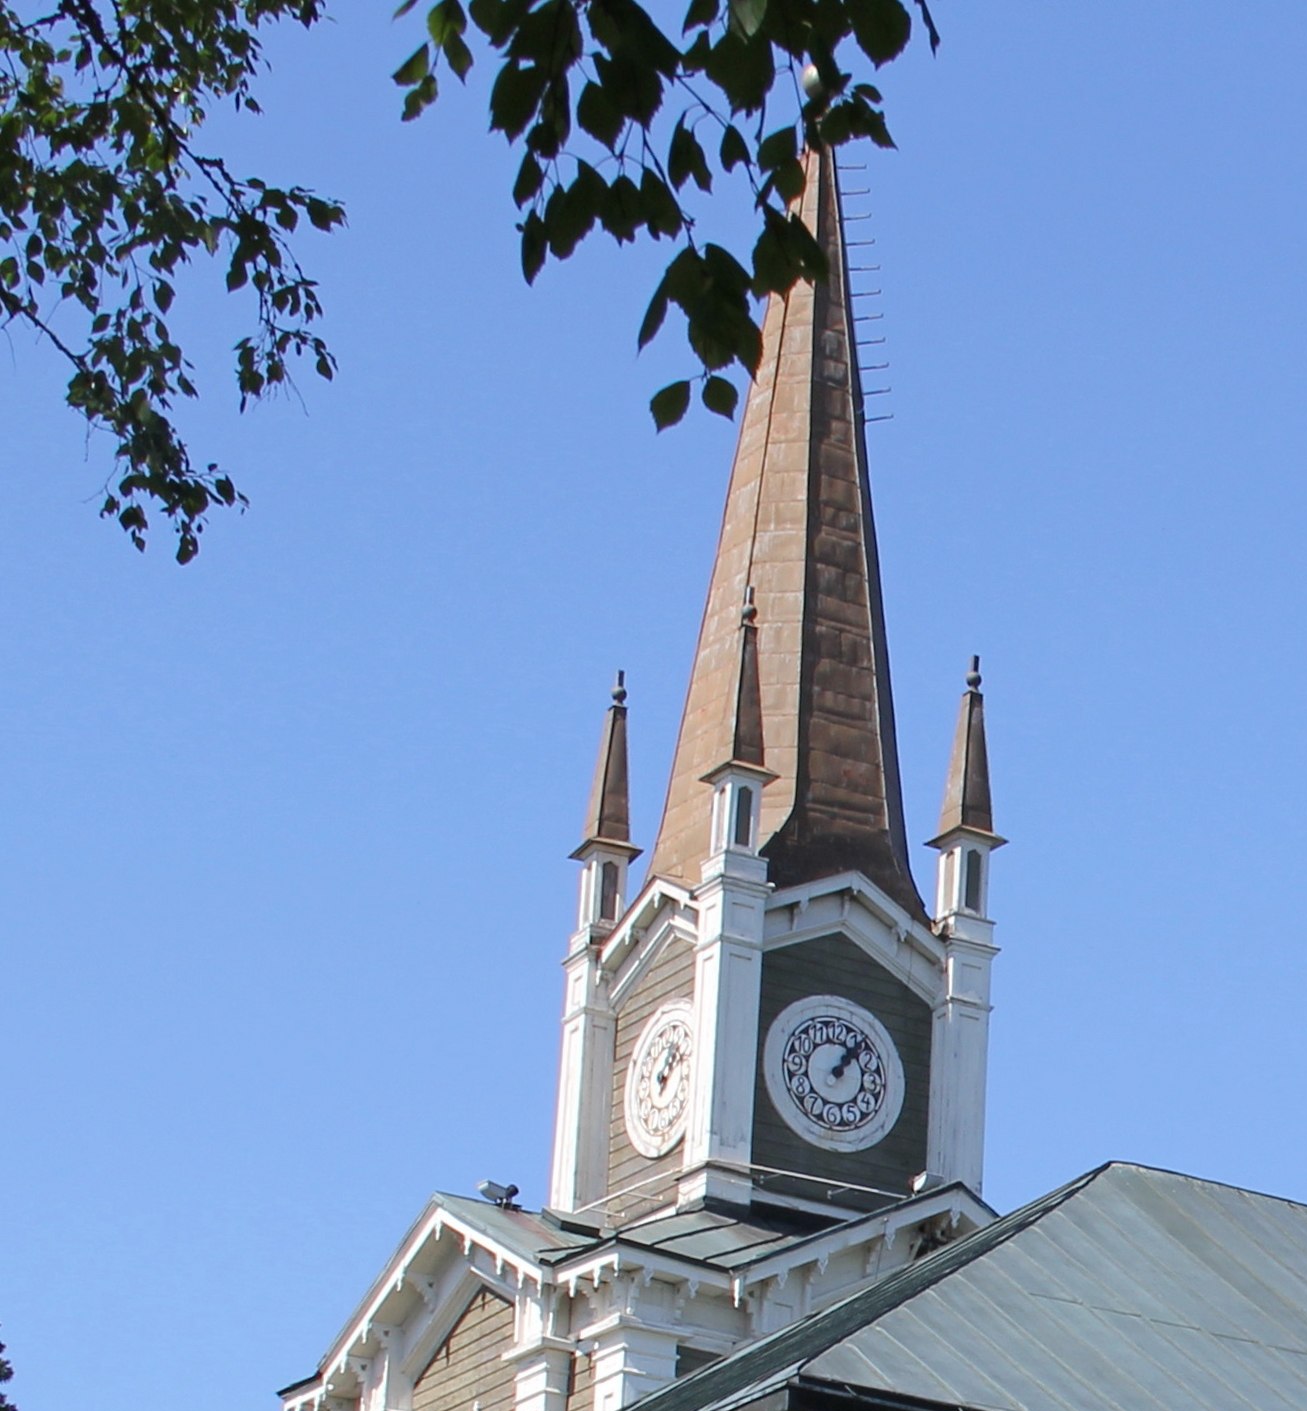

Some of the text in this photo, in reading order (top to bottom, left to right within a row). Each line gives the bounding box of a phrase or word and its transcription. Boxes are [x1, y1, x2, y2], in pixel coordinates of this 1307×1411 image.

[811, 1024, 824, 1040] 11
[828, 1023, 843, 1041] 12
[796, 1034, 812, 1053] 10
[792, 1055, 804, 1074] 9
[864, 1052, 873, 1071] 2
[796, 1077, 805, 1096] 8
[869, 1073, 878, 1094] 3
[809, 1095, 818, 1114] 7
[861, 1092, 871, 1112] 4
[826, 1105, 838, 1125] 6
[846, 1105, 857, 1123] 5
